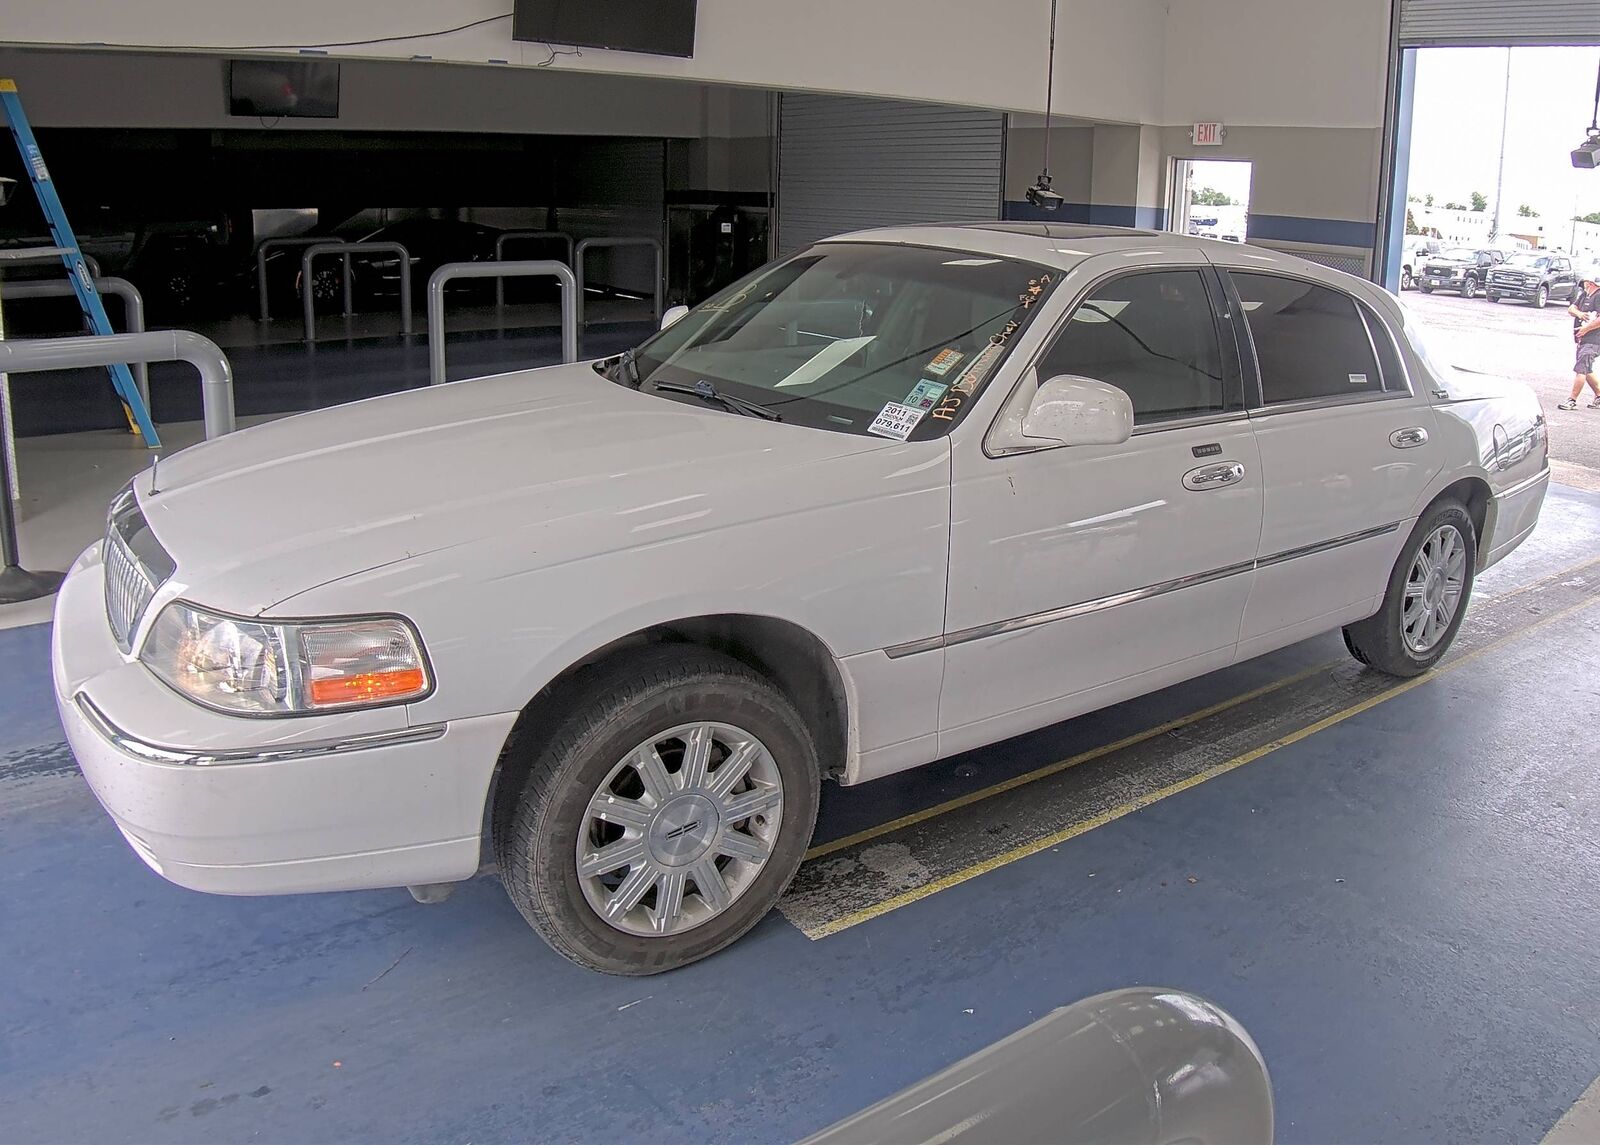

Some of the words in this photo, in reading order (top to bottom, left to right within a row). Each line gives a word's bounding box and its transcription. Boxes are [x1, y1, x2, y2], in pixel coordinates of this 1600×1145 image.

[1197, 123, 1217, 142] EXIT
[882, 412, 903, 421] LINCOLN
[885, 406, 907, 417] 2011
